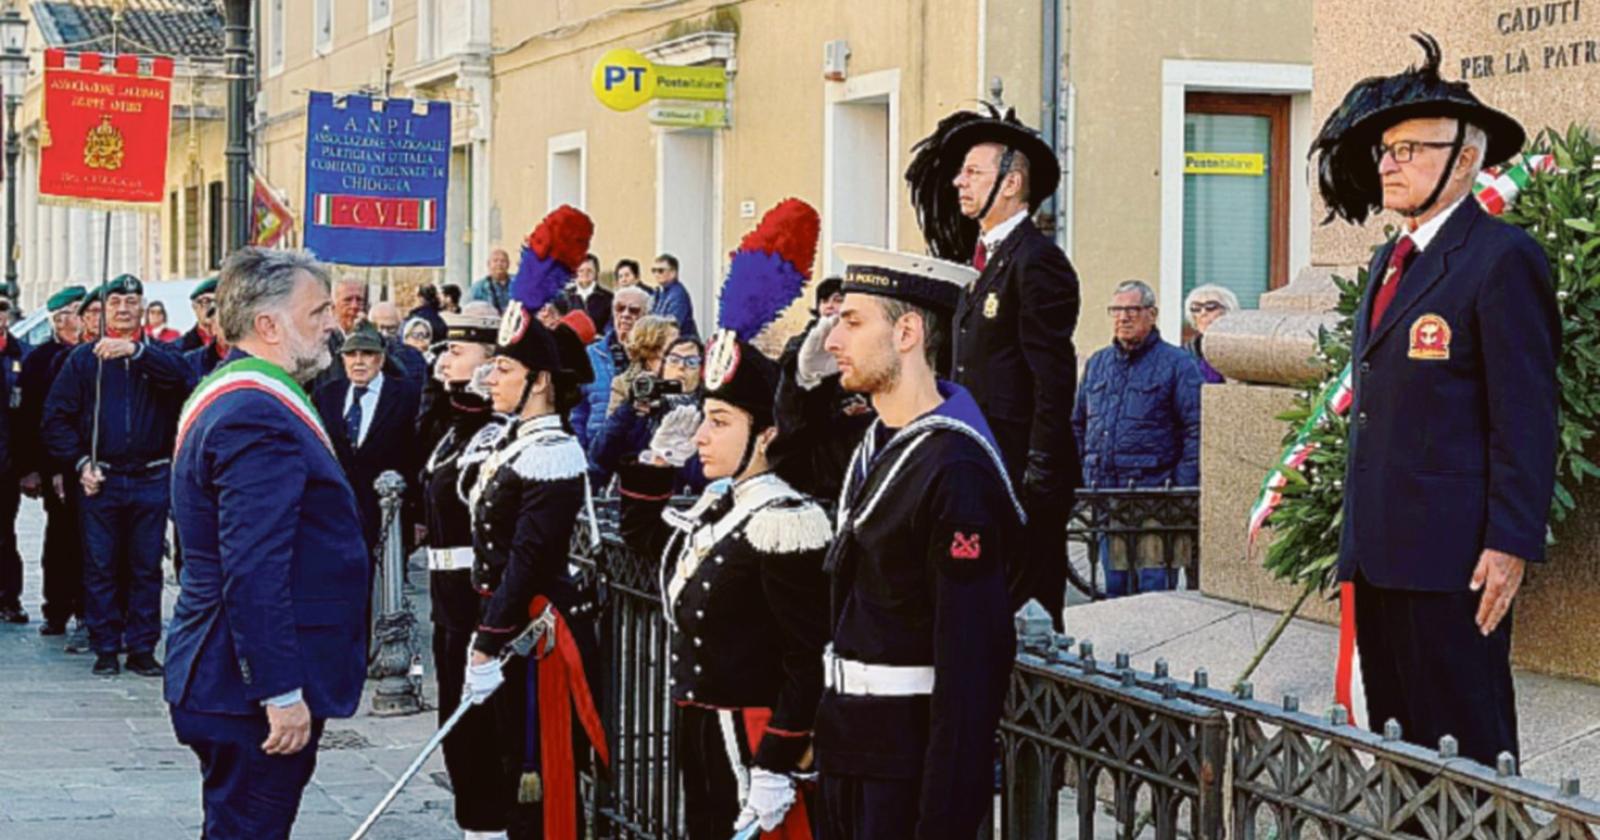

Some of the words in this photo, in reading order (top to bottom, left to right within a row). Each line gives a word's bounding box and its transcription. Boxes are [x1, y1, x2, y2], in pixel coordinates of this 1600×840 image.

[1497, 0, 1580, 35] CADUTI
[1460, 54, 1495, 79] PER
[1505, 48, 1530, 74] LA
[1543, 40, 1599, 69] PATR
[604, 65, 647, 92] PT
